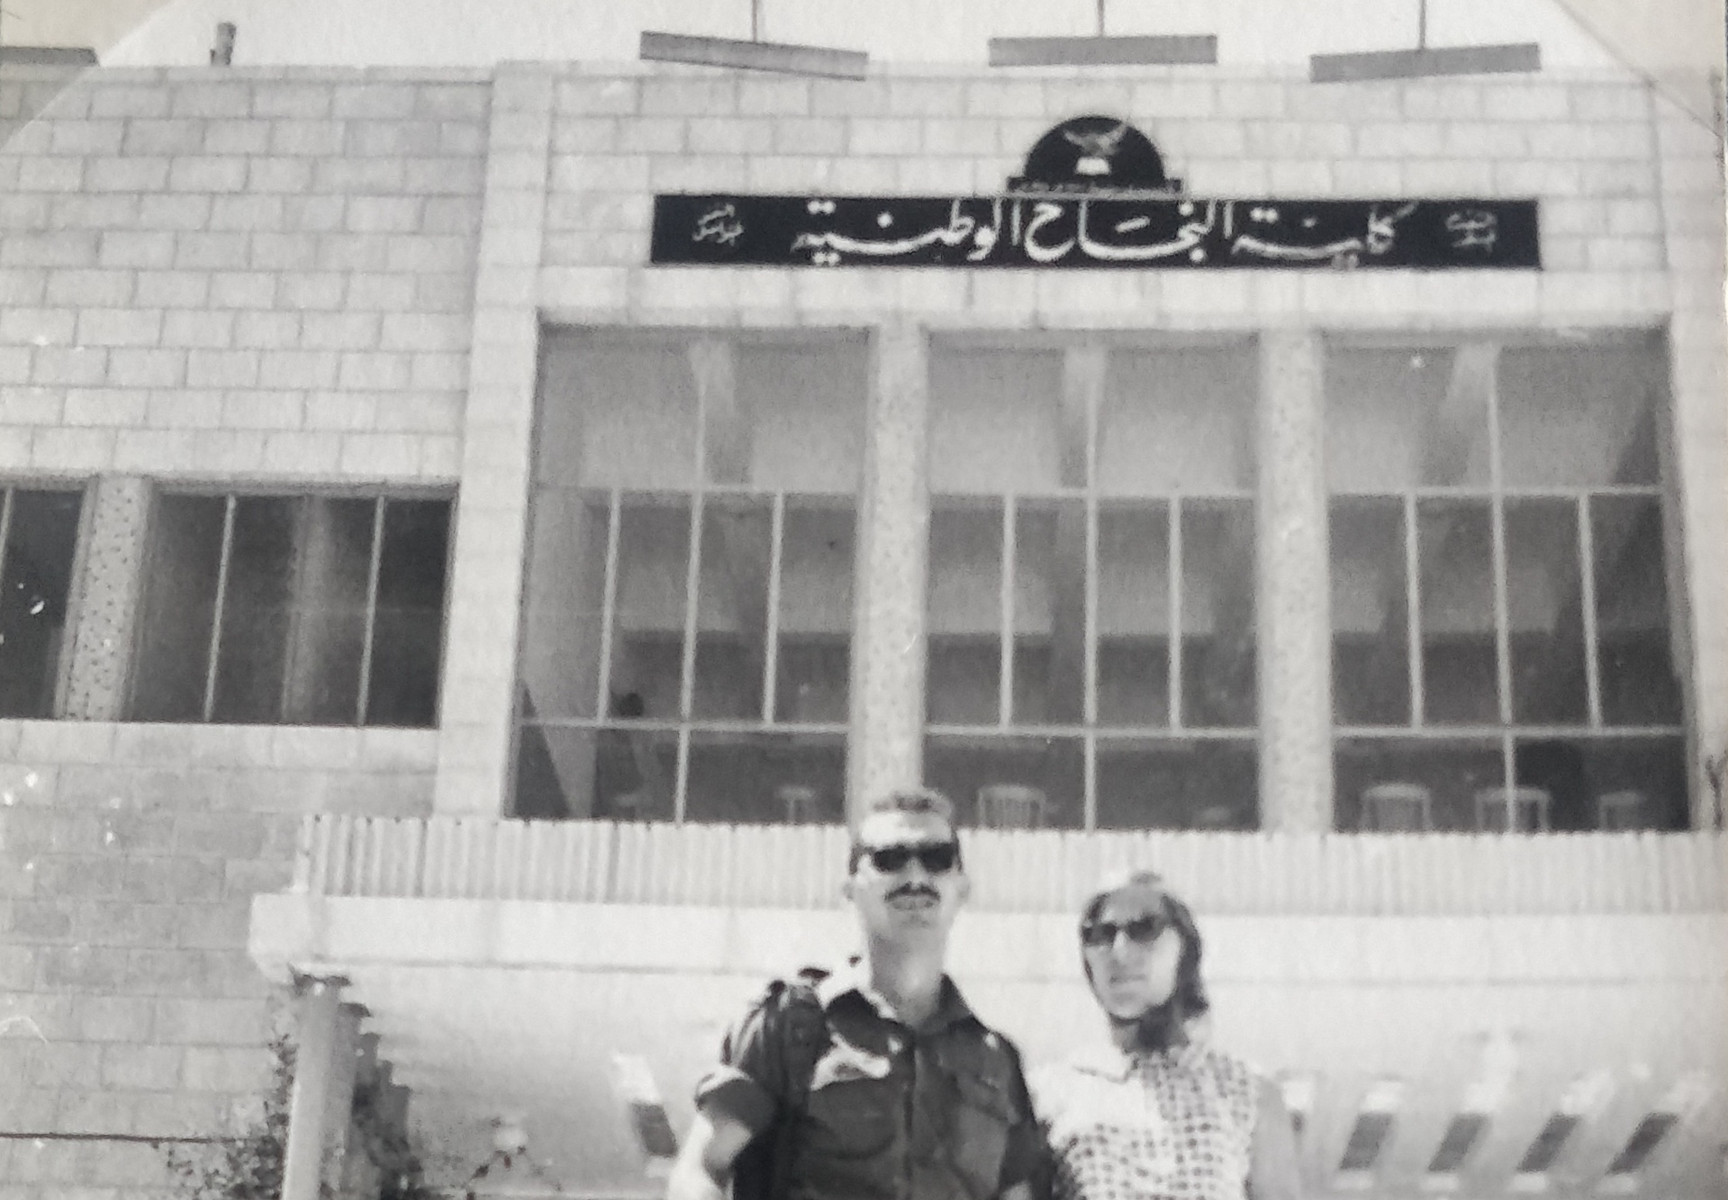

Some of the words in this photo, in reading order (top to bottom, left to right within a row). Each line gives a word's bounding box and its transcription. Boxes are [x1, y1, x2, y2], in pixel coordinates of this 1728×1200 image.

[790, 198, 1022, 265] الوطنية
[1024, 199, 1235, 263] النجاح
[1231, 200, 1421, 268] كلية
